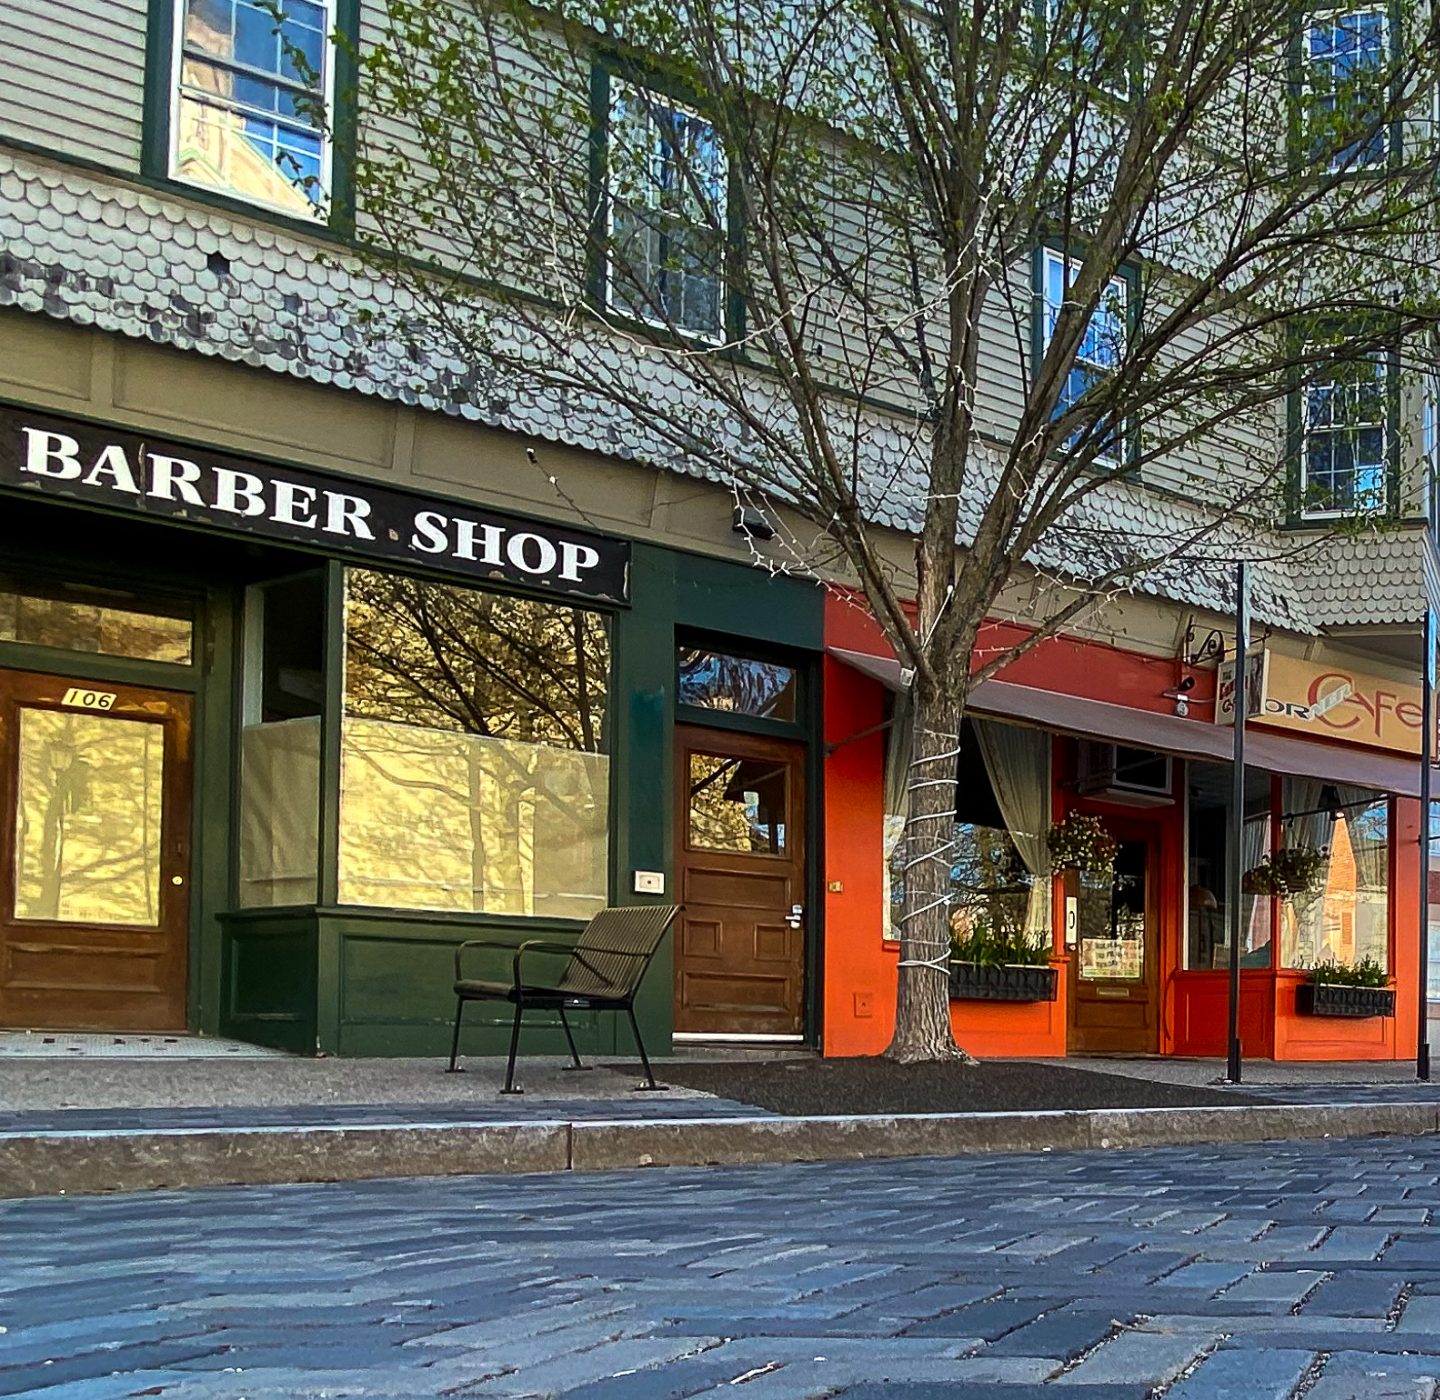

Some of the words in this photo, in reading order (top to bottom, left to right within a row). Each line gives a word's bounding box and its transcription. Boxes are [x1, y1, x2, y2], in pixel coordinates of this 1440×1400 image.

[20, 427, 377, 541] BARBER
[411, 511, 600, 582] SHOP
[69, 690, 112, 708] 106
